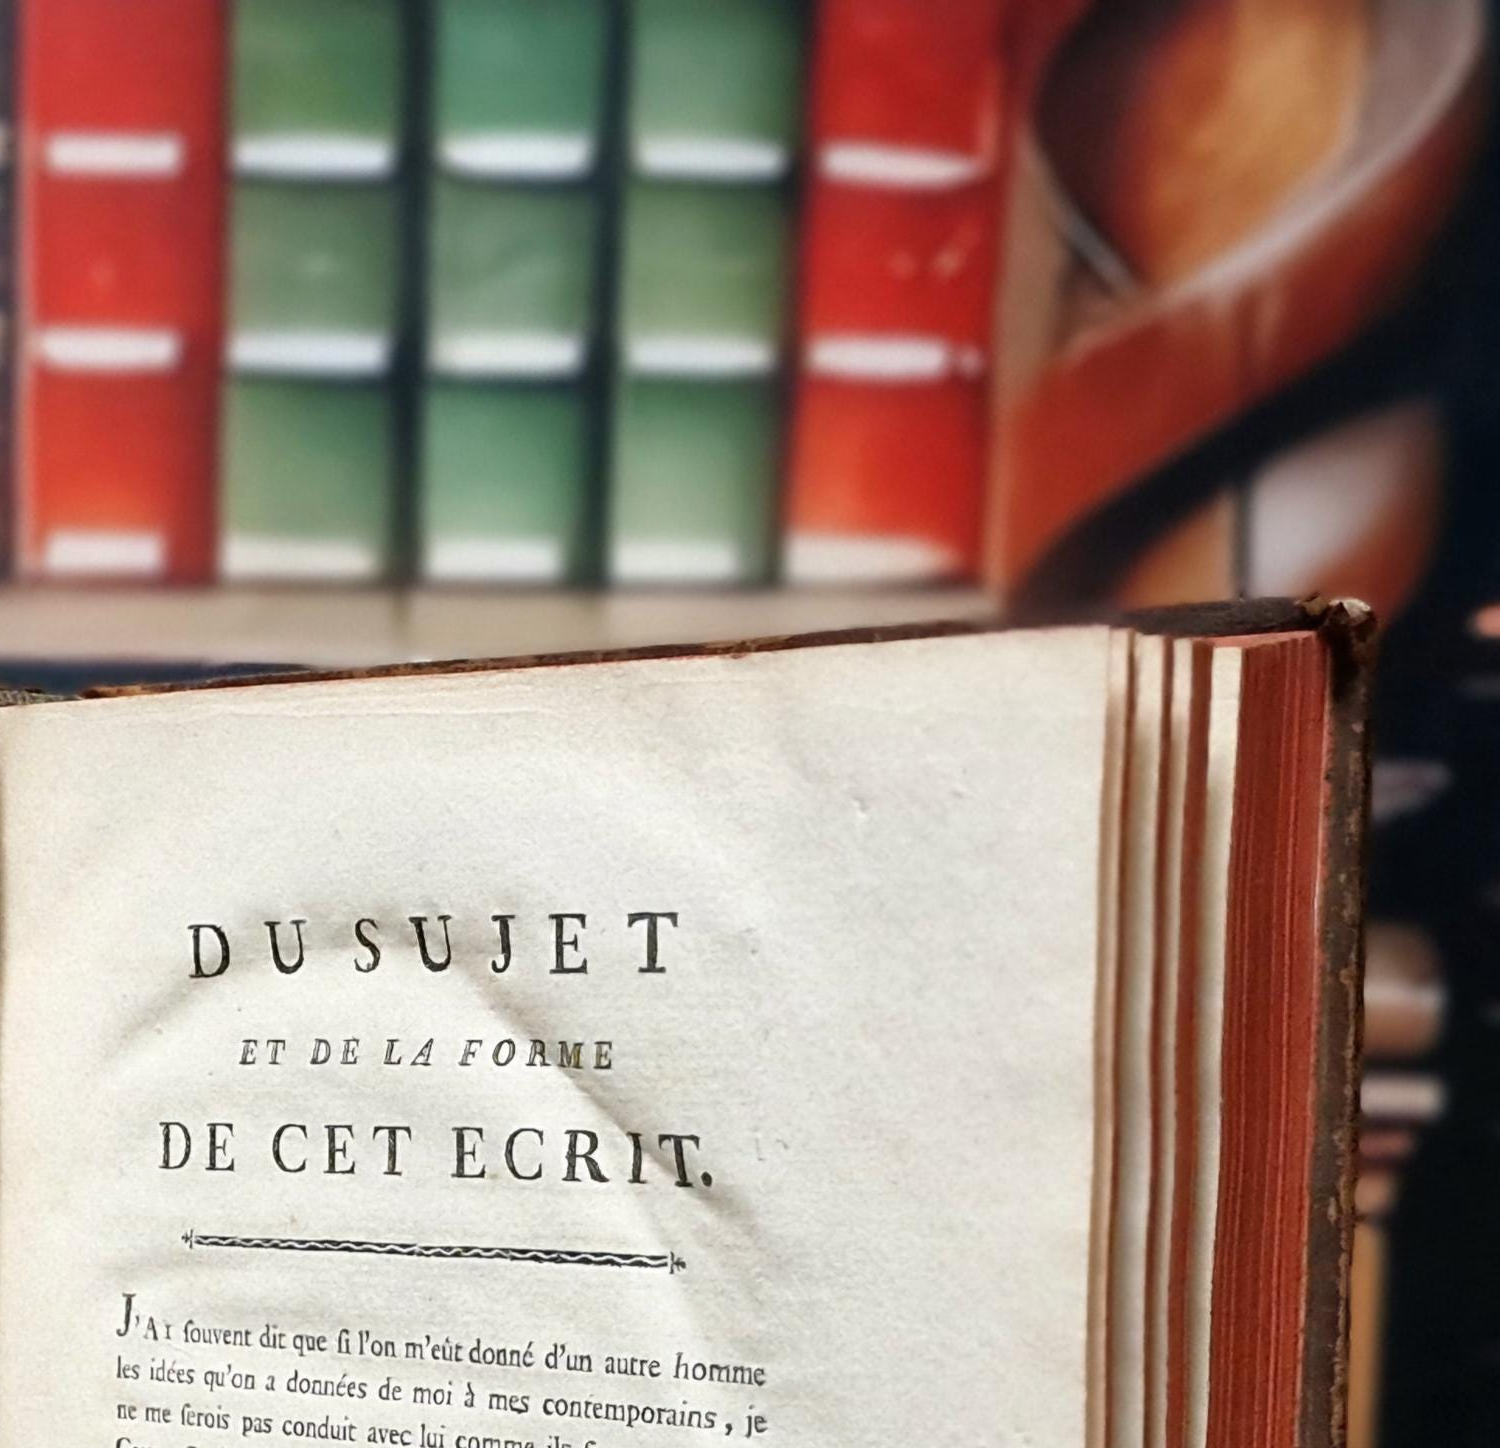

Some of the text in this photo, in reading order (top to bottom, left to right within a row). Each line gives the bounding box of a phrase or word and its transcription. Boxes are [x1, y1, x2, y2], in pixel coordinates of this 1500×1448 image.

[353, 911, 679, 977] SUJET
[239, 1036, 616, 1071] ET DE LA FORME
[157, 1120, 716, 1189] DE CET ECRIT.
[116, 1355, 141, 1380] les
[149, 1358, 195, 1385] idées
[264, 1375, 276, 1392] a
[286, 1369, 368, 1399] données
[378, 1376, 402, 1401] de
[412, 1380, 453, 1406] moi
[463, 1381, 476, 1409] à
[488, 1393, 530, 1415] mes
[744, 1404, 768, 1439] je
[116, 1403, 137, 1421] ne
[145, 1406, 171, 1424] me
[241, 1415, 273, 1437] pas
[281, 1415, 357, 1442] conduit
[366, 1426, 412, 1447] avec
[419, 1423, 446, 1448] lui
